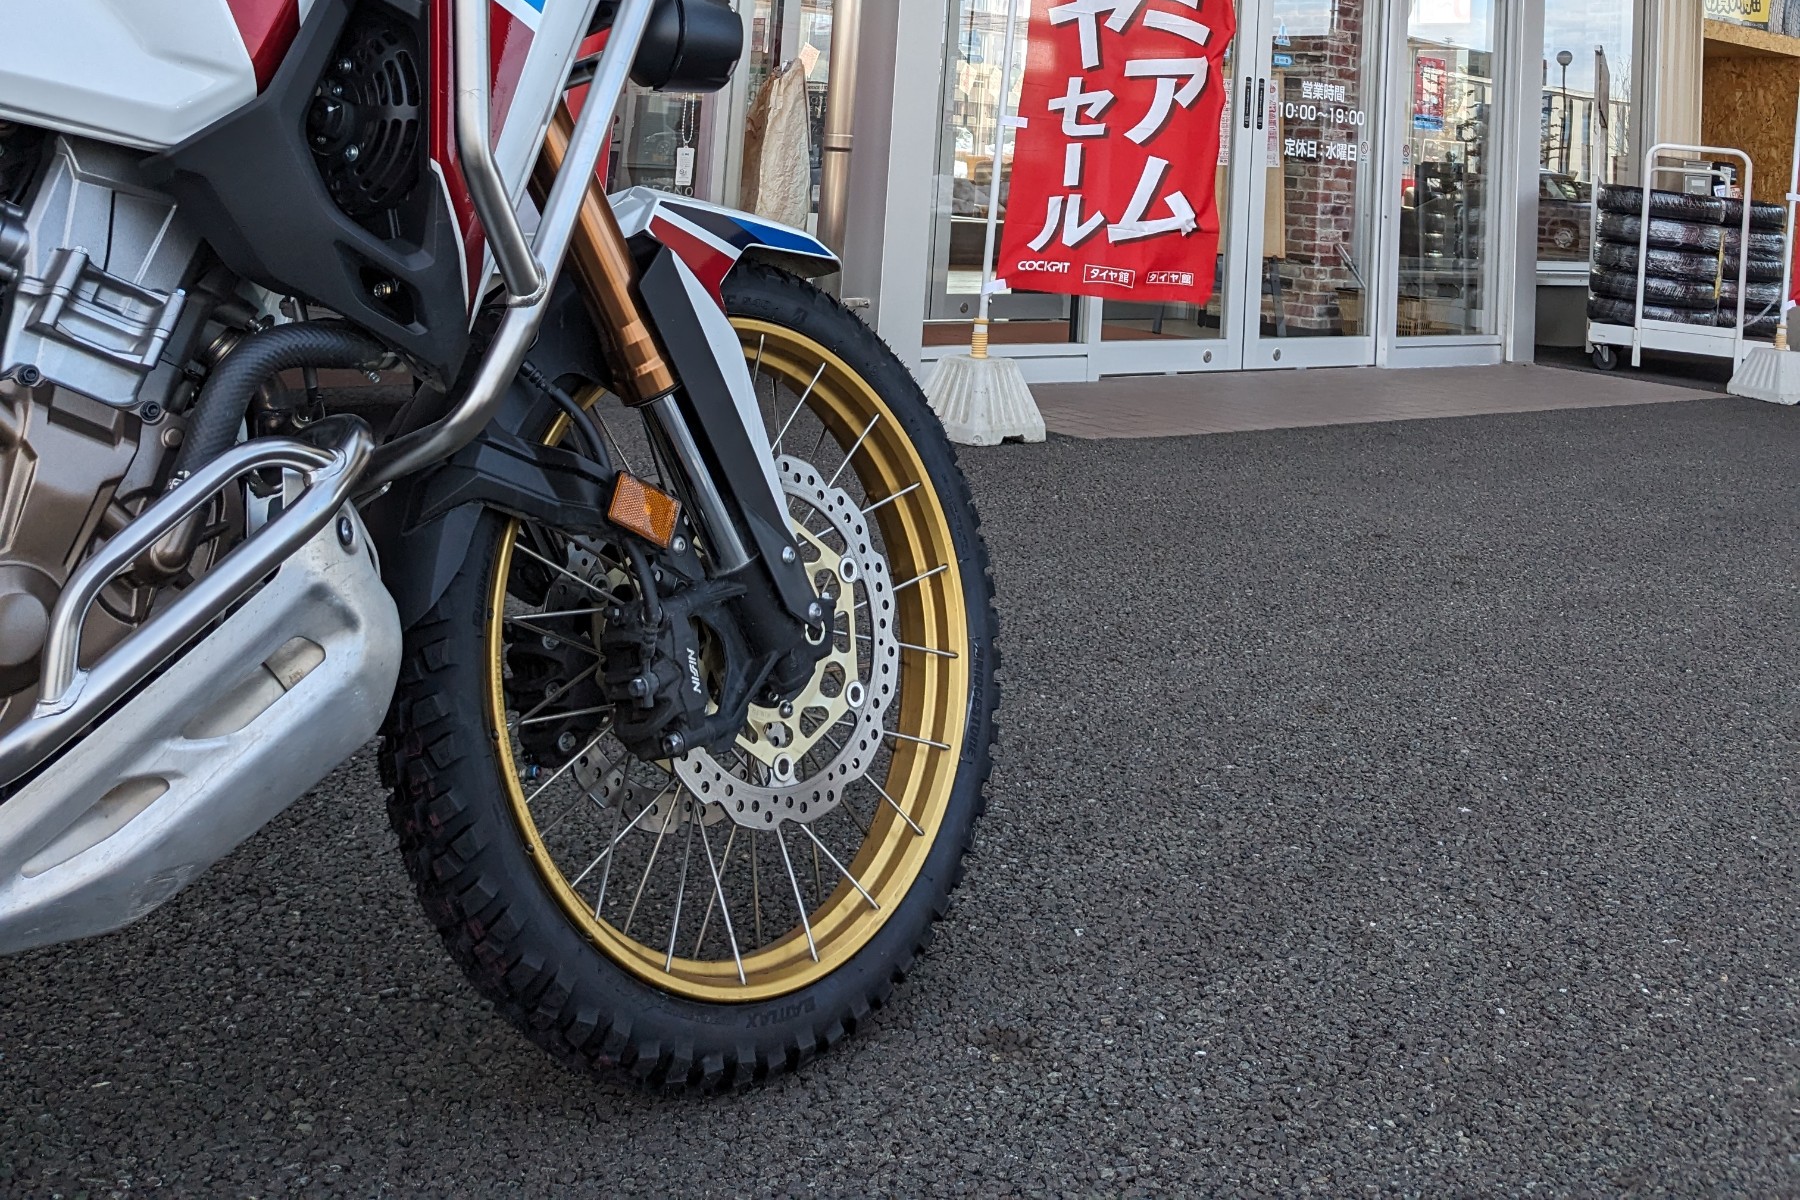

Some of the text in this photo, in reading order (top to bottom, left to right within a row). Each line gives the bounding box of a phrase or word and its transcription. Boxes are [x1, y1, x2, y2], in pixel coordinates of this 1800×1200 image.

[1302, 81, 1345, 102] 営業時間
[1017, 260, 1070, 274] COCKPIT
[1089, 268, 1130, 284] タイヤ館
